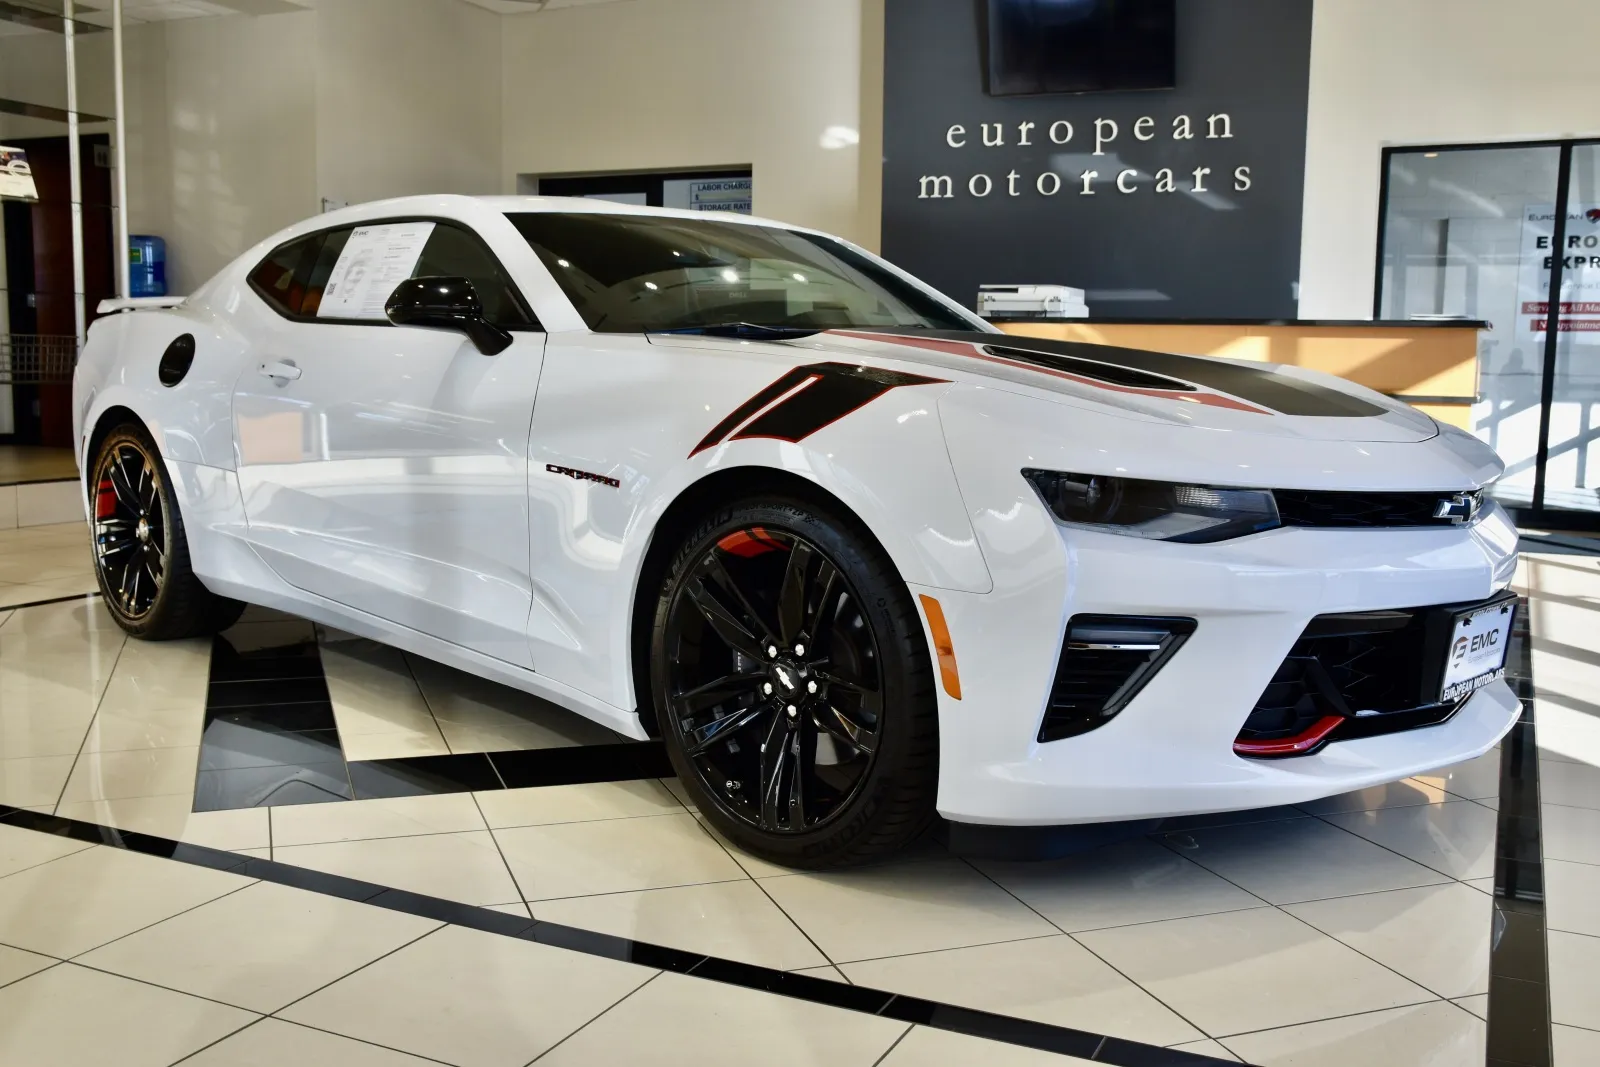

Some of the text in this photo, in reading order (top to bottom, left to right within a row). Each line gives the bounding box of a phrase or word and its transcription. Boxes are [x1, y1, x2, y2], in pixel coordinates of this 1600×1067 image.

[945, 112, 1234, 156] european
[697, 183, 722, 191] LABOR
[917, 165, 1252, 199] motorcars
[698, 203, 732, 211] STORAGE
[1536, 235, 1598, 249] ERO
[1470, 628, 1499, 653] EMC
